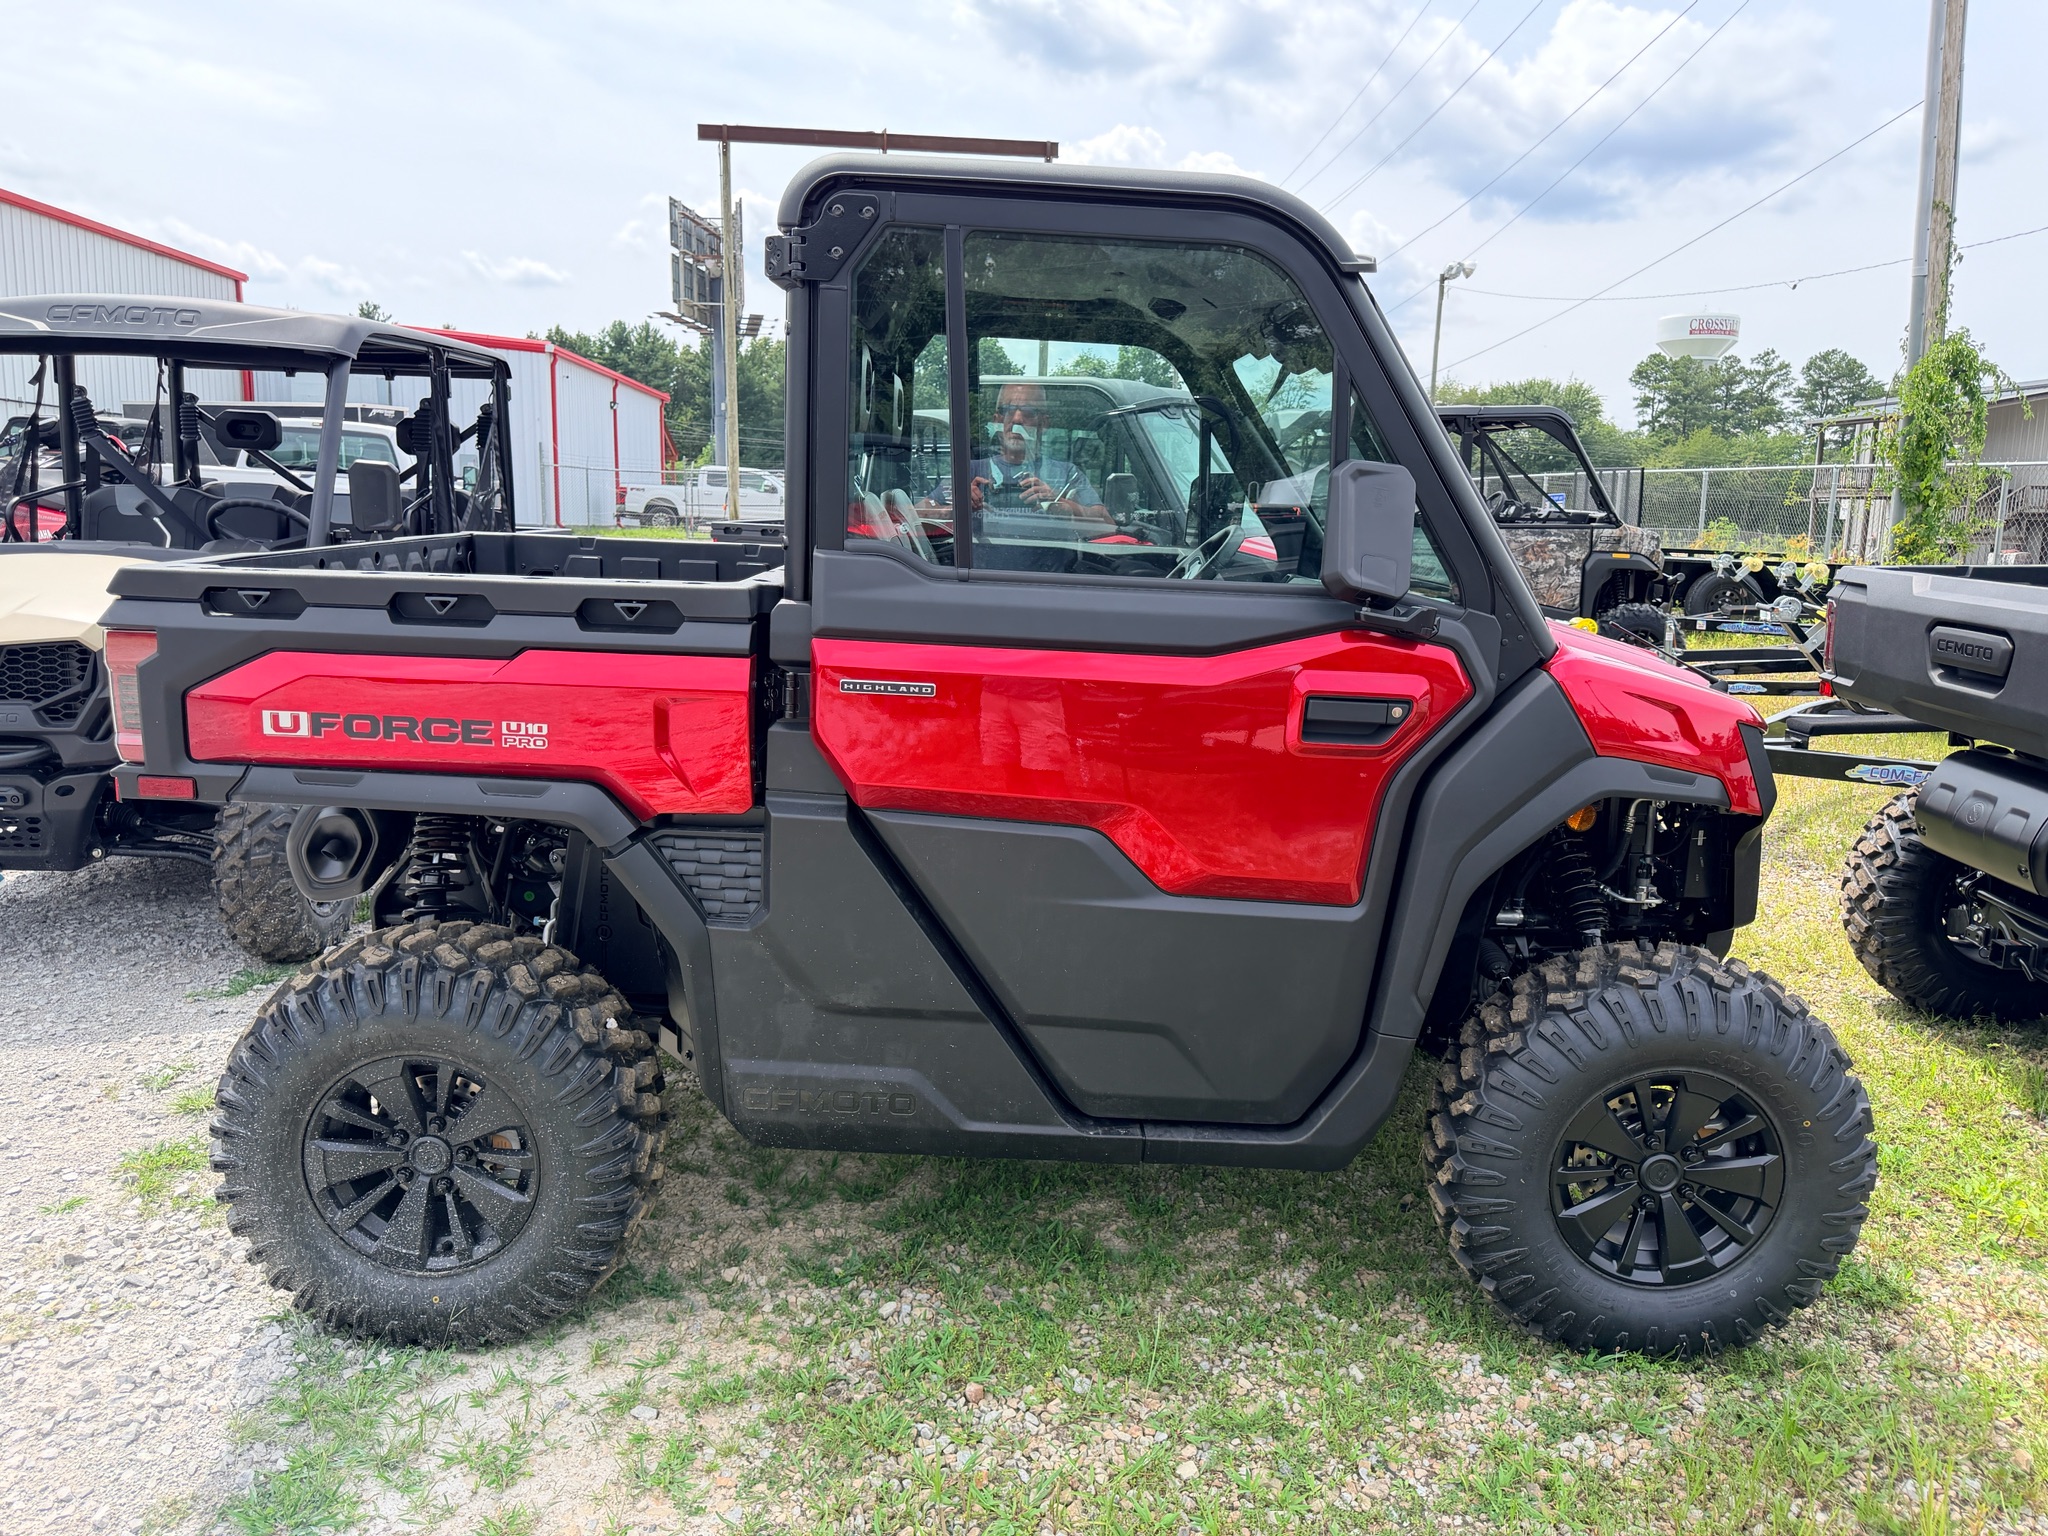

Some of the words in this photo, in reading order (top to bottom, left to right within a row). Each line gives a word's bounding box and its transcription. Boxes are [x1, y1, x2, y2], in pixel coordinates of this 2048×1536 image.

[46, 304, 202, 327] CFMOTO
[1937, 638, 1994, 661] CFMOTO
[843, 683, 932, 694] HIGHLAND
[502, 721, 548, 735] U10
[502, 736, 548, 750] PRO
[742, 1087, 917, 1116] CFMOTO
